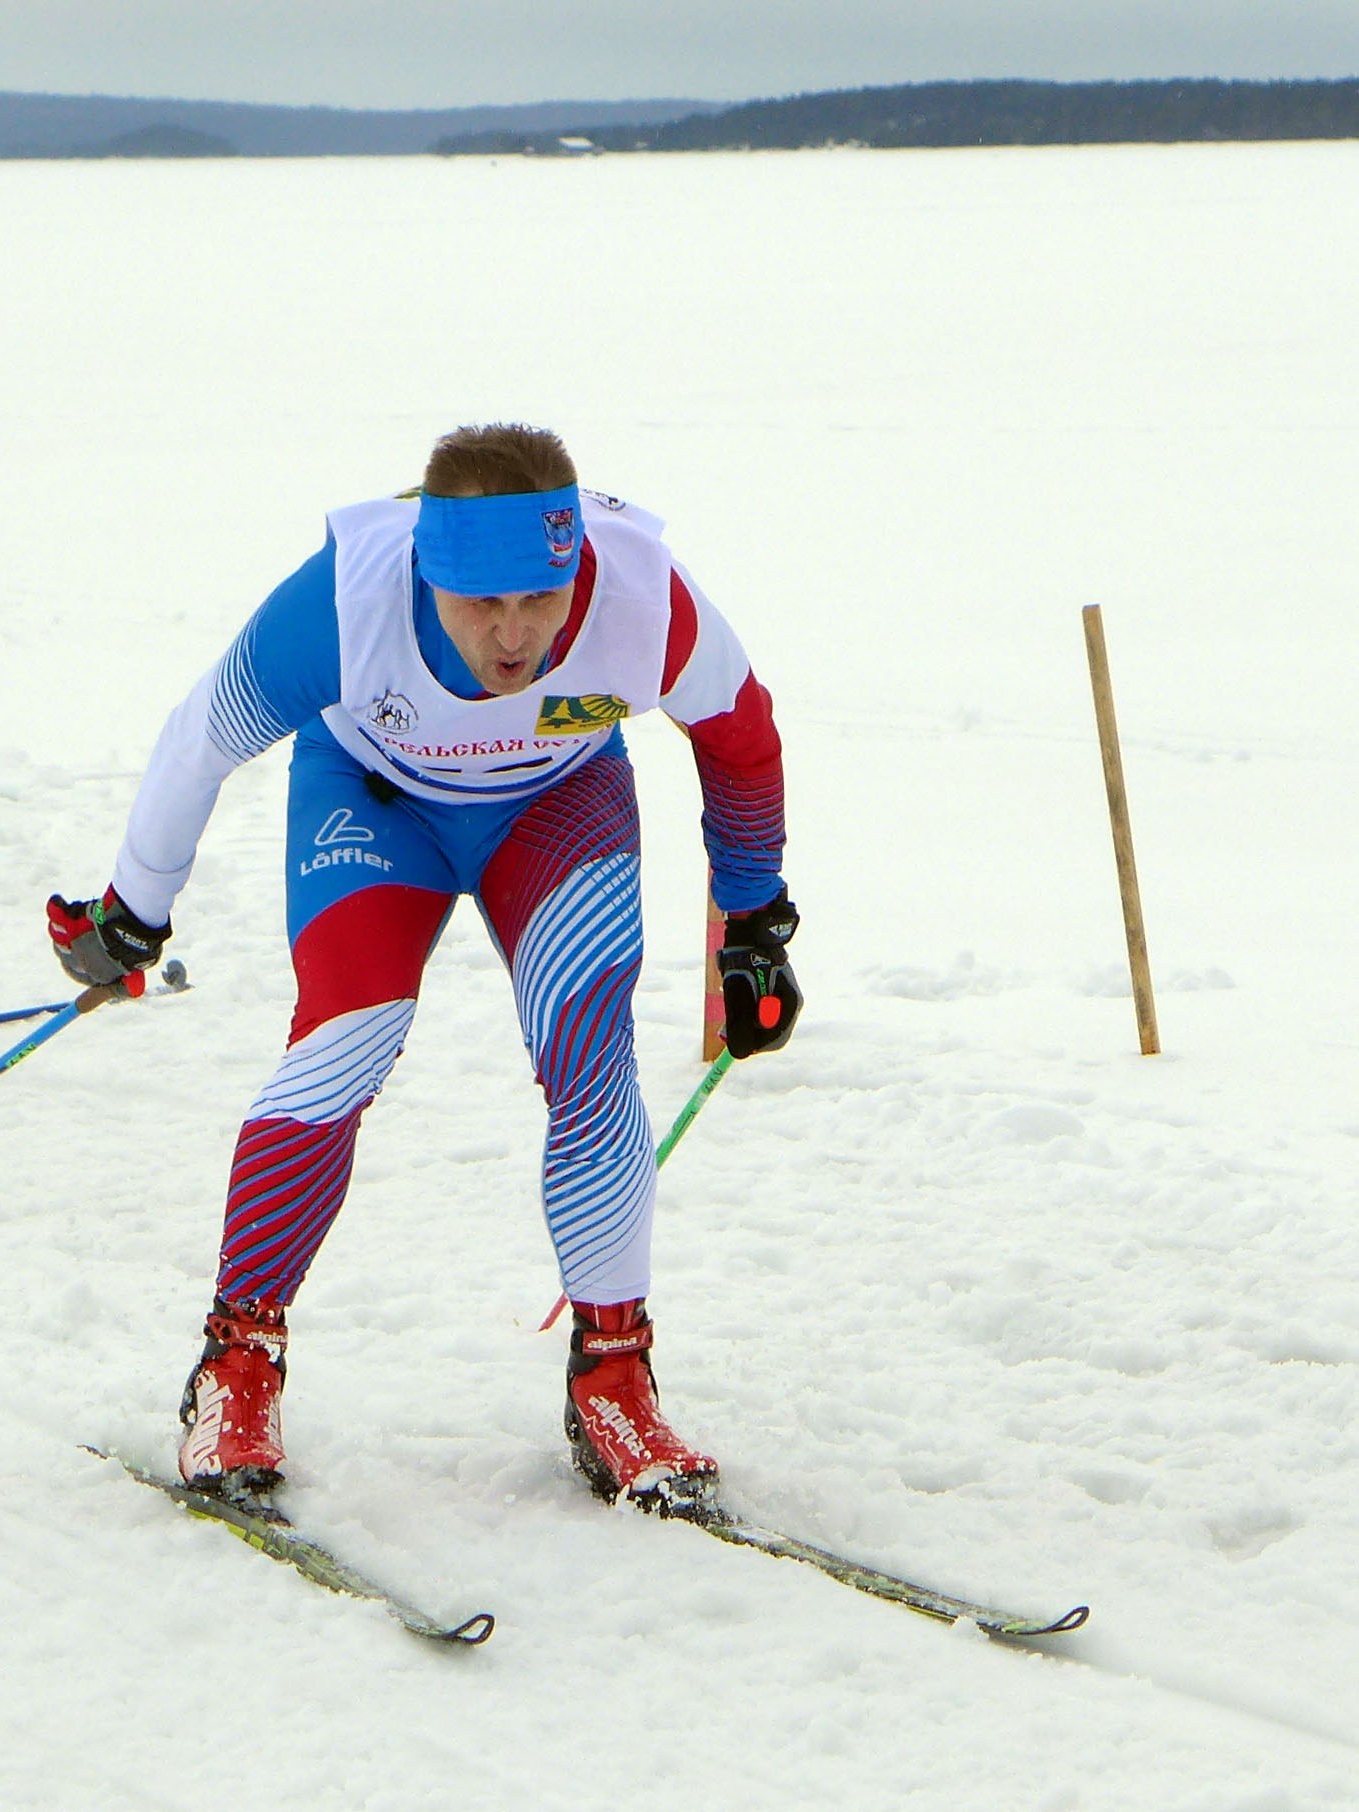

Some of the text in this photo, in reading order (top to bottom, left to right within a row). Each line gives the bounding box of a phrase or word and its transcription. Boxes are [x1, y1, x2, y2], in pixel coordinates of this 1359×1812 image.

[300, 847, 394, 877] Löffler
[587, 1336, 638, 1351] alpina
[588, 1395, 647, 1459] alpina
